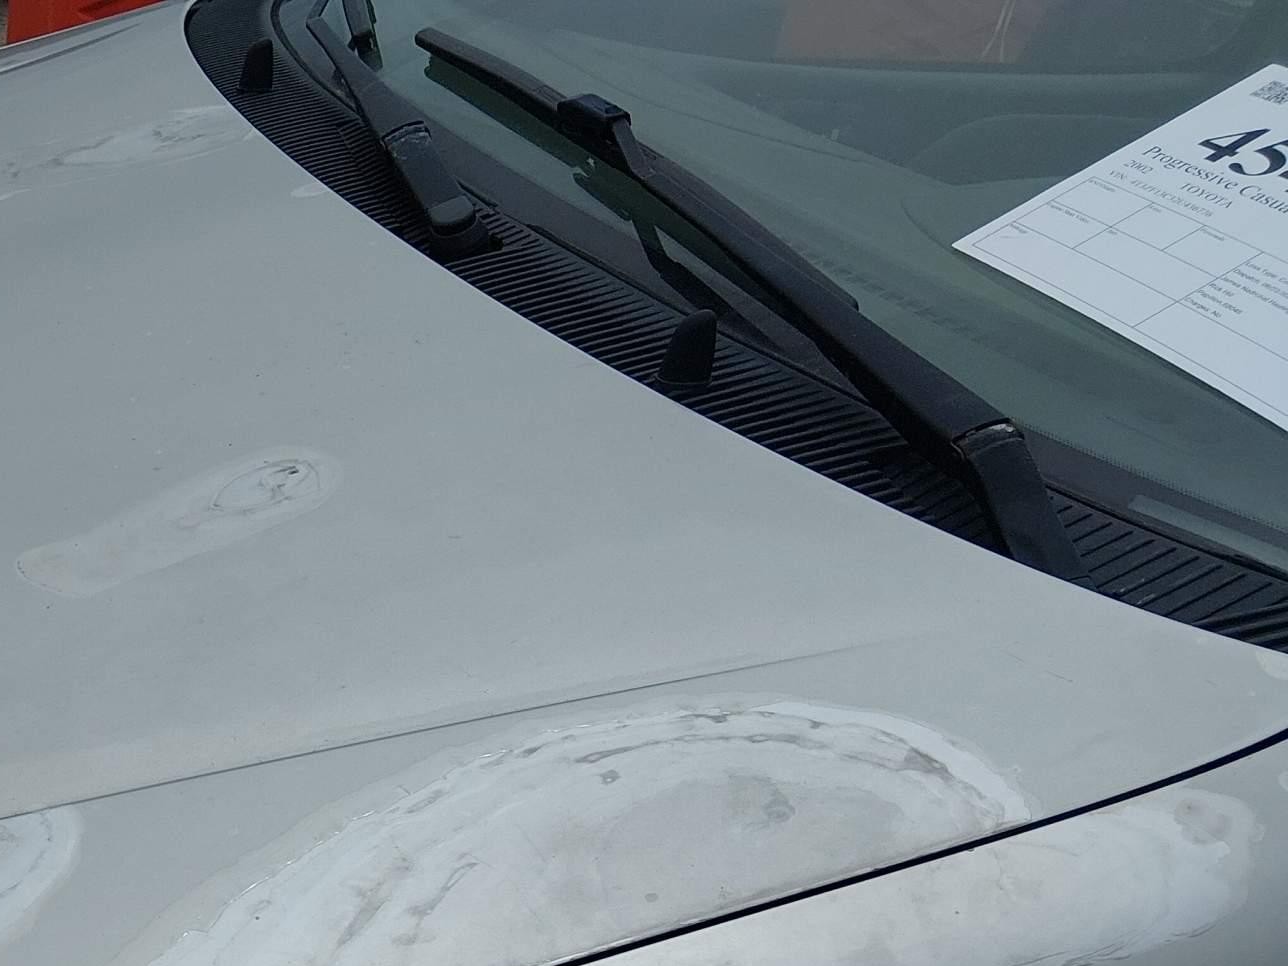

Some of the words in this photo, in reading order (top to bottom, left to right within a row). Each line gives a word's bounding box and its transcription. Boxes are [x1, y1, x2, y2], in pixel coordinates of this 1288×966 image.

[1122, 159, 1154, 174] 2002
[1142, 146, 1238, 189] Progressive
[1197, 128, 1288, 192] 45
[1179, 183, 1233, 208] TOYOTA
